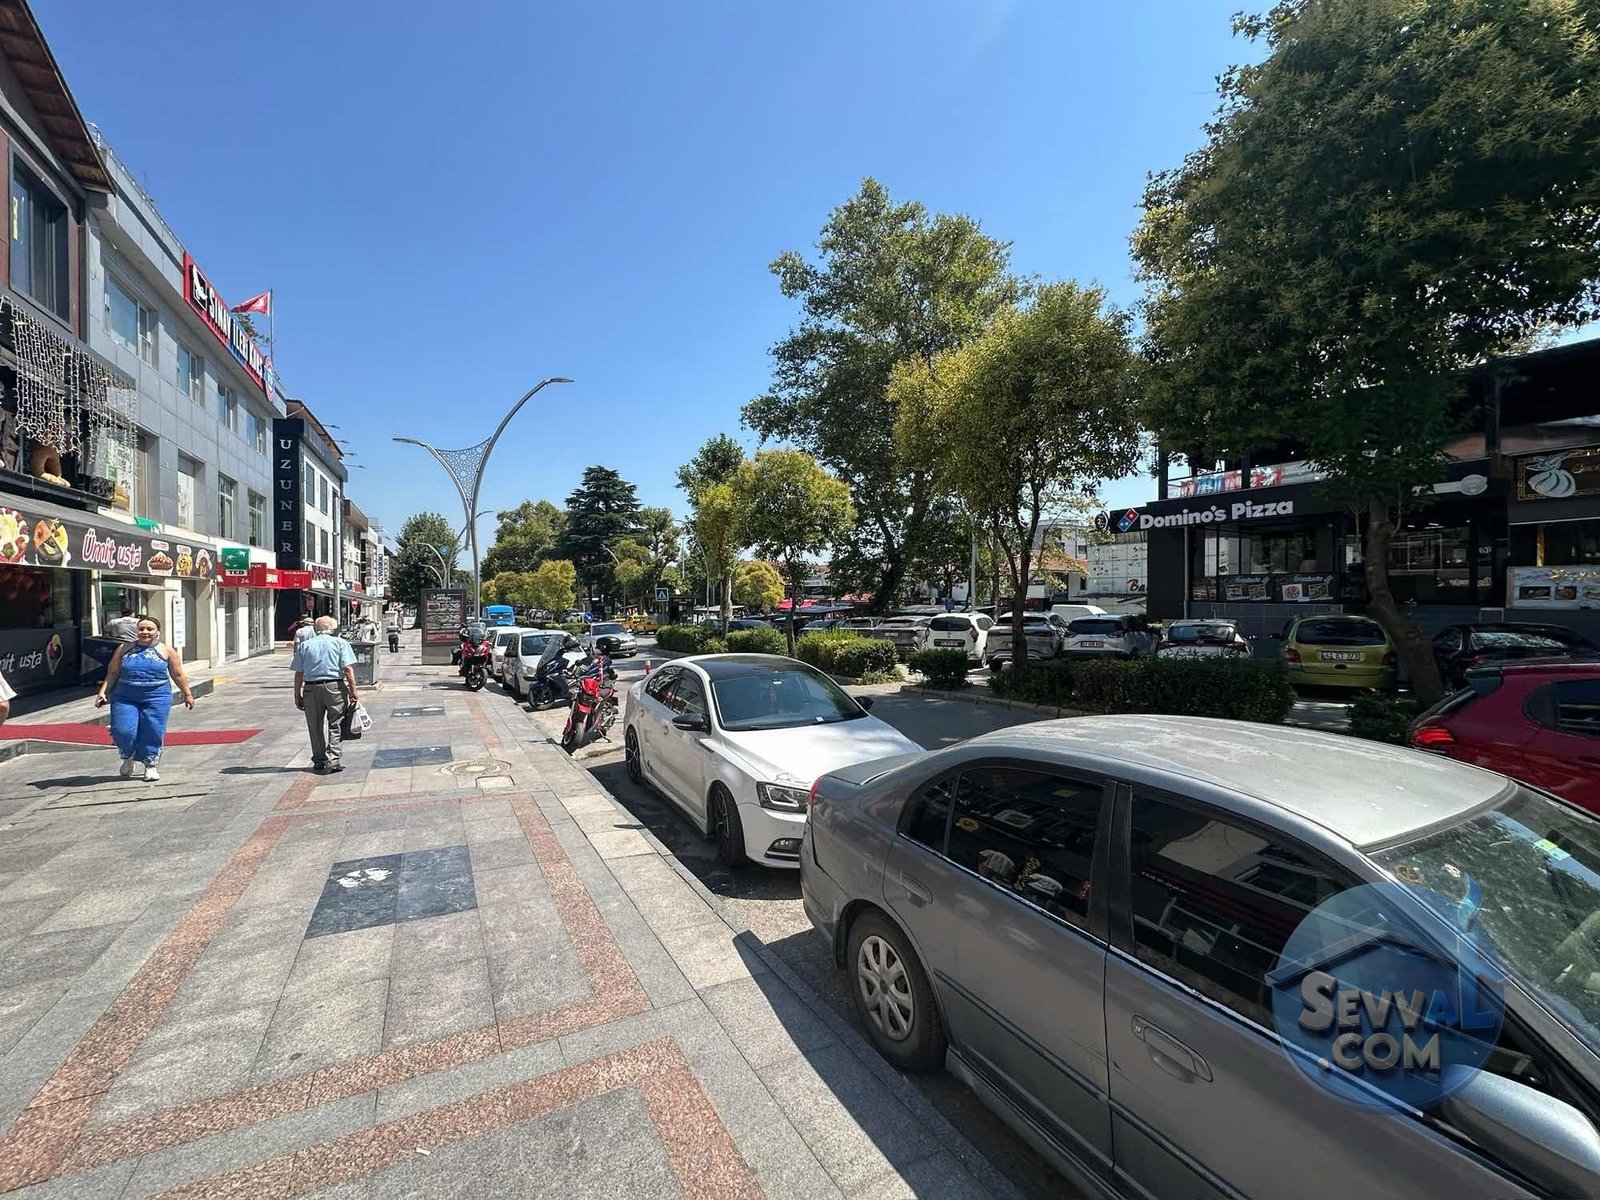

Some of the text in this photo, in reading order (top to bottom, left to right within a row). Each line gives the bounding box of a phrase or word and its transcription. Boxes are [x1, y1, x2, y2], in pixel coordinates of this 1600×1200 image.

[279, 438, 294, 553] UZUNER
[1139, 499, 1294, 530] Domino's Pizza
[82, 527, 142, 571] Ümit usta
[20, 651, 42, 669] usta
